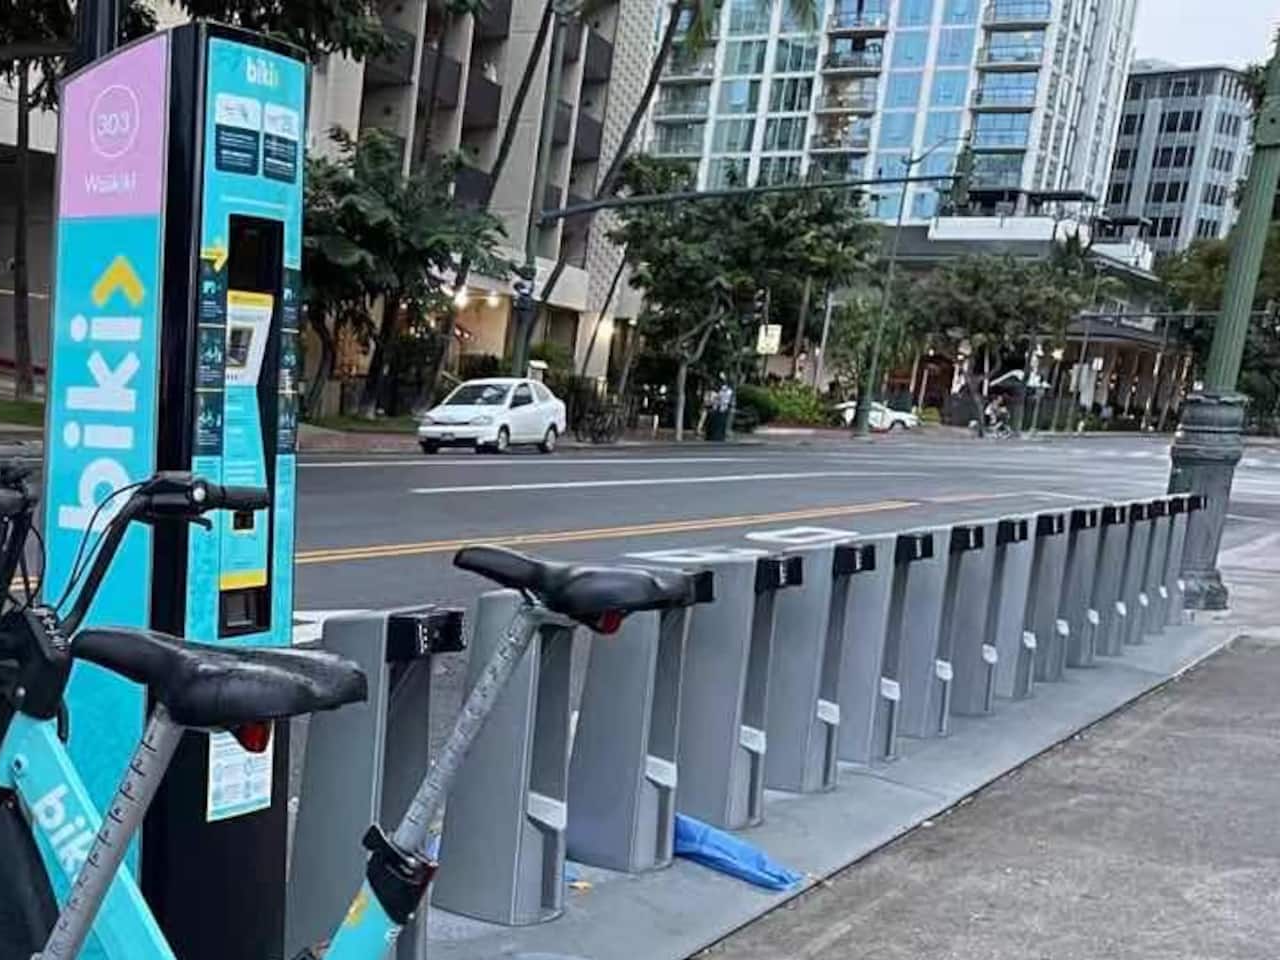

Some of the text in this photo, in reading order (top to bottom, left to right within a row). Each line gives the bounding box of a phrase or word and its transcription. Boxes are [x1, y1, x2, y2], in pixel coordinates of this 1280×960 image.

[96, 111, 130, 137] 303
[58, 315, 143, 530] biki
[31, 783, 93, 883] bik
